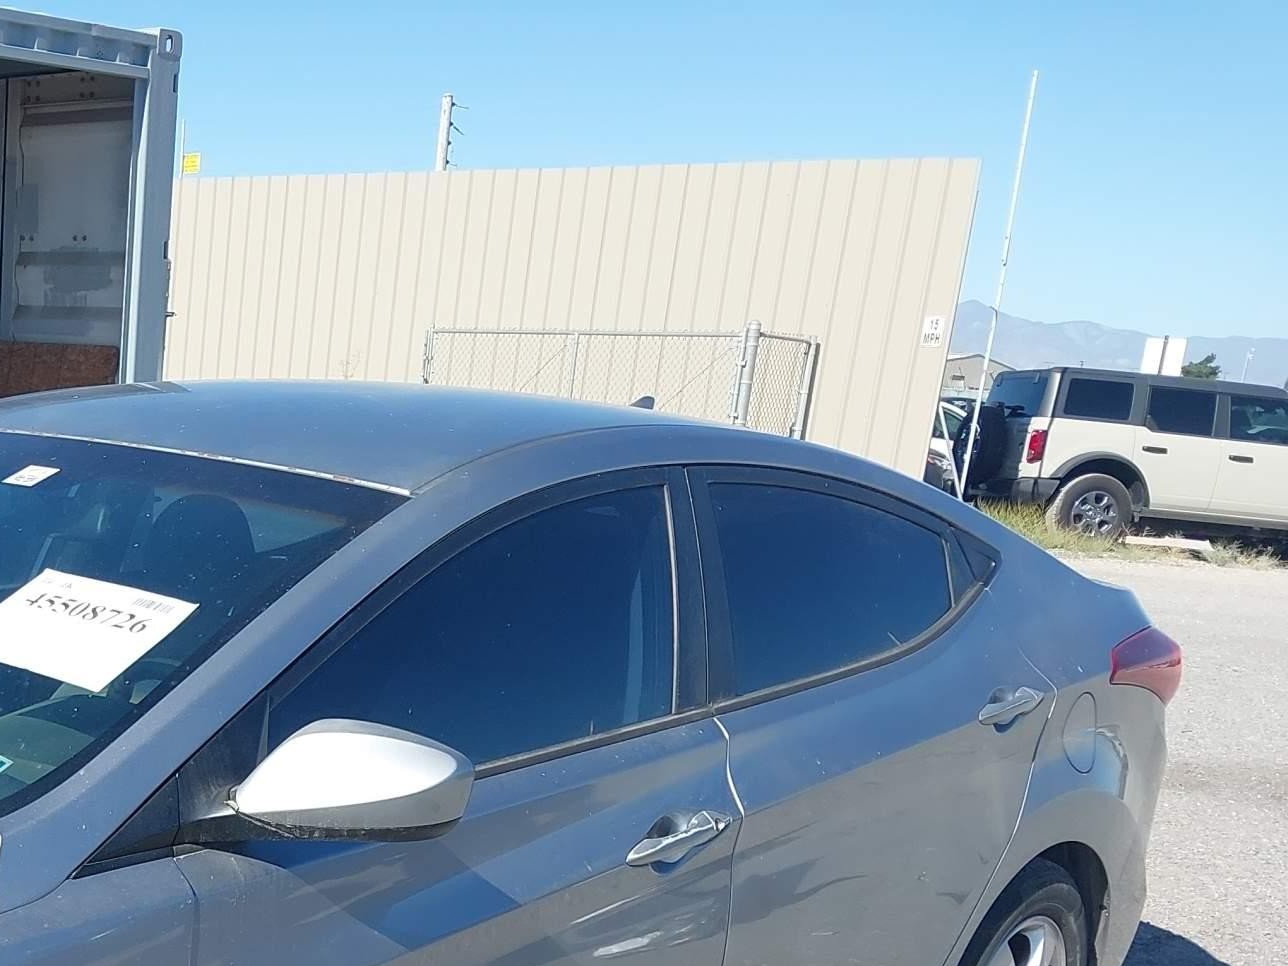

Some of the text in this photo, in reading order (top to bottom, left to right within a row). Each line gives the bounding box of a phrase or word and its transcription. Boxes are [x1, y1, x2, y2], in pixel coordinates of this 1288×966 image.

[930, 319, 940, 330] 15
[922, 332, 940, 344] MPH
[25, 592, 152, 634] 45508726
